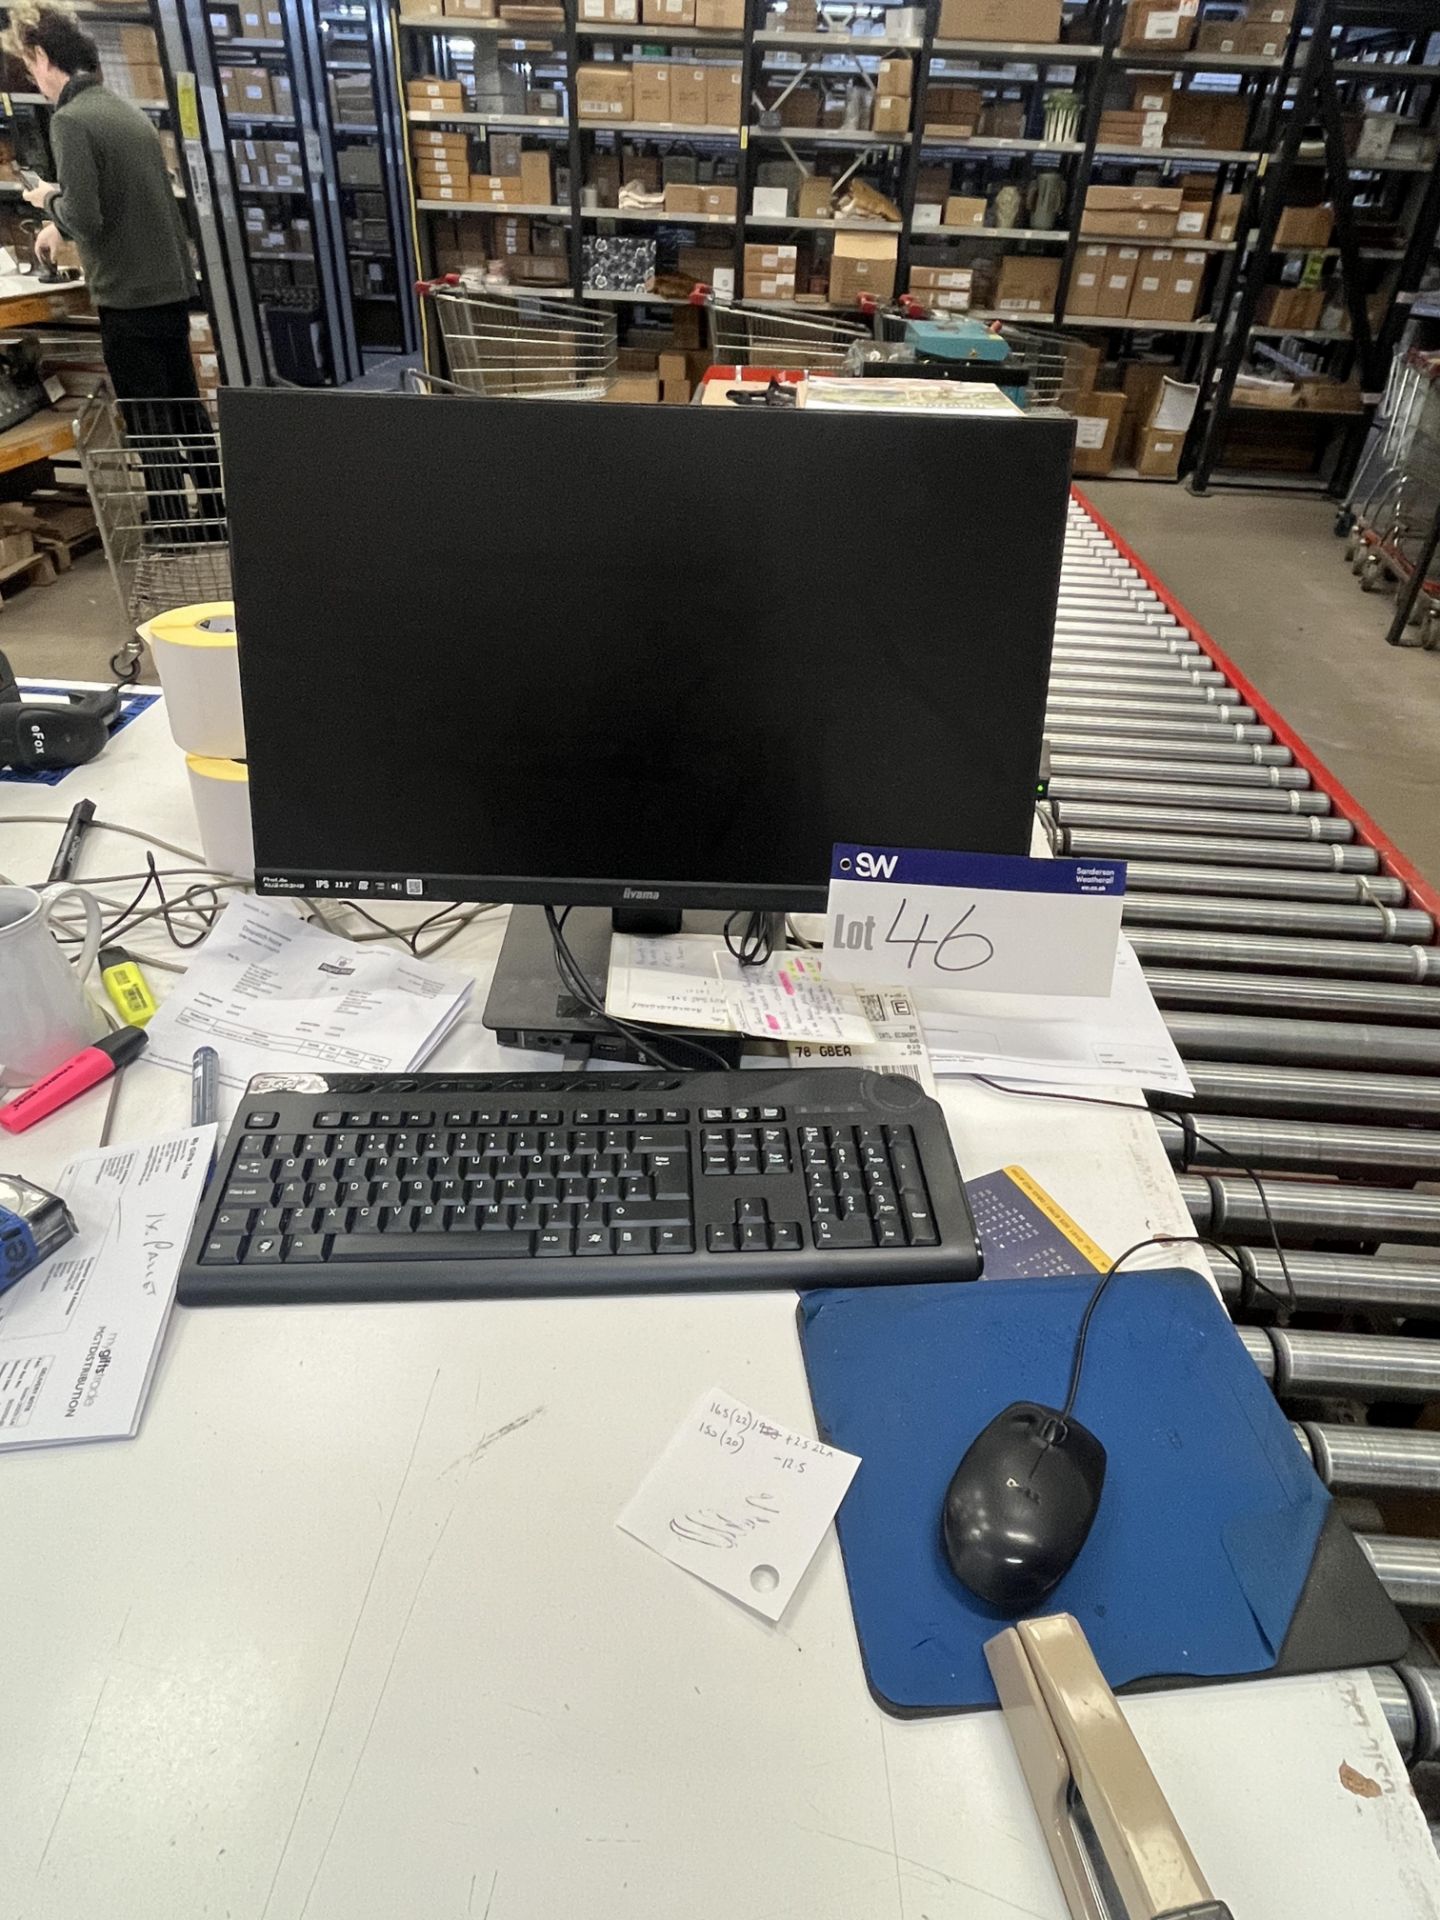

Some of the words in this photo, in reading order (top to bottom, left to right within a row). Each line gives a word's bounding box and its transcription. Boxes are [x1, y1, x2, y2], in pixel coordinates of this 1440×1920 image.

[855, 852, 899, 879] SW
[1076, 867, 1115, 876] Sanderson
[315, 879, 329, 889] IPS
[1076, 875, 1115, 884] Weatherall
[623, 887, 660, 900] iiyama
[832, 913, 876, 951] Lot
[884, 898, 994, 972] 46
[794, 1044, 811, 1057] 78
[819, 1045, 852, 1057] GBEA
